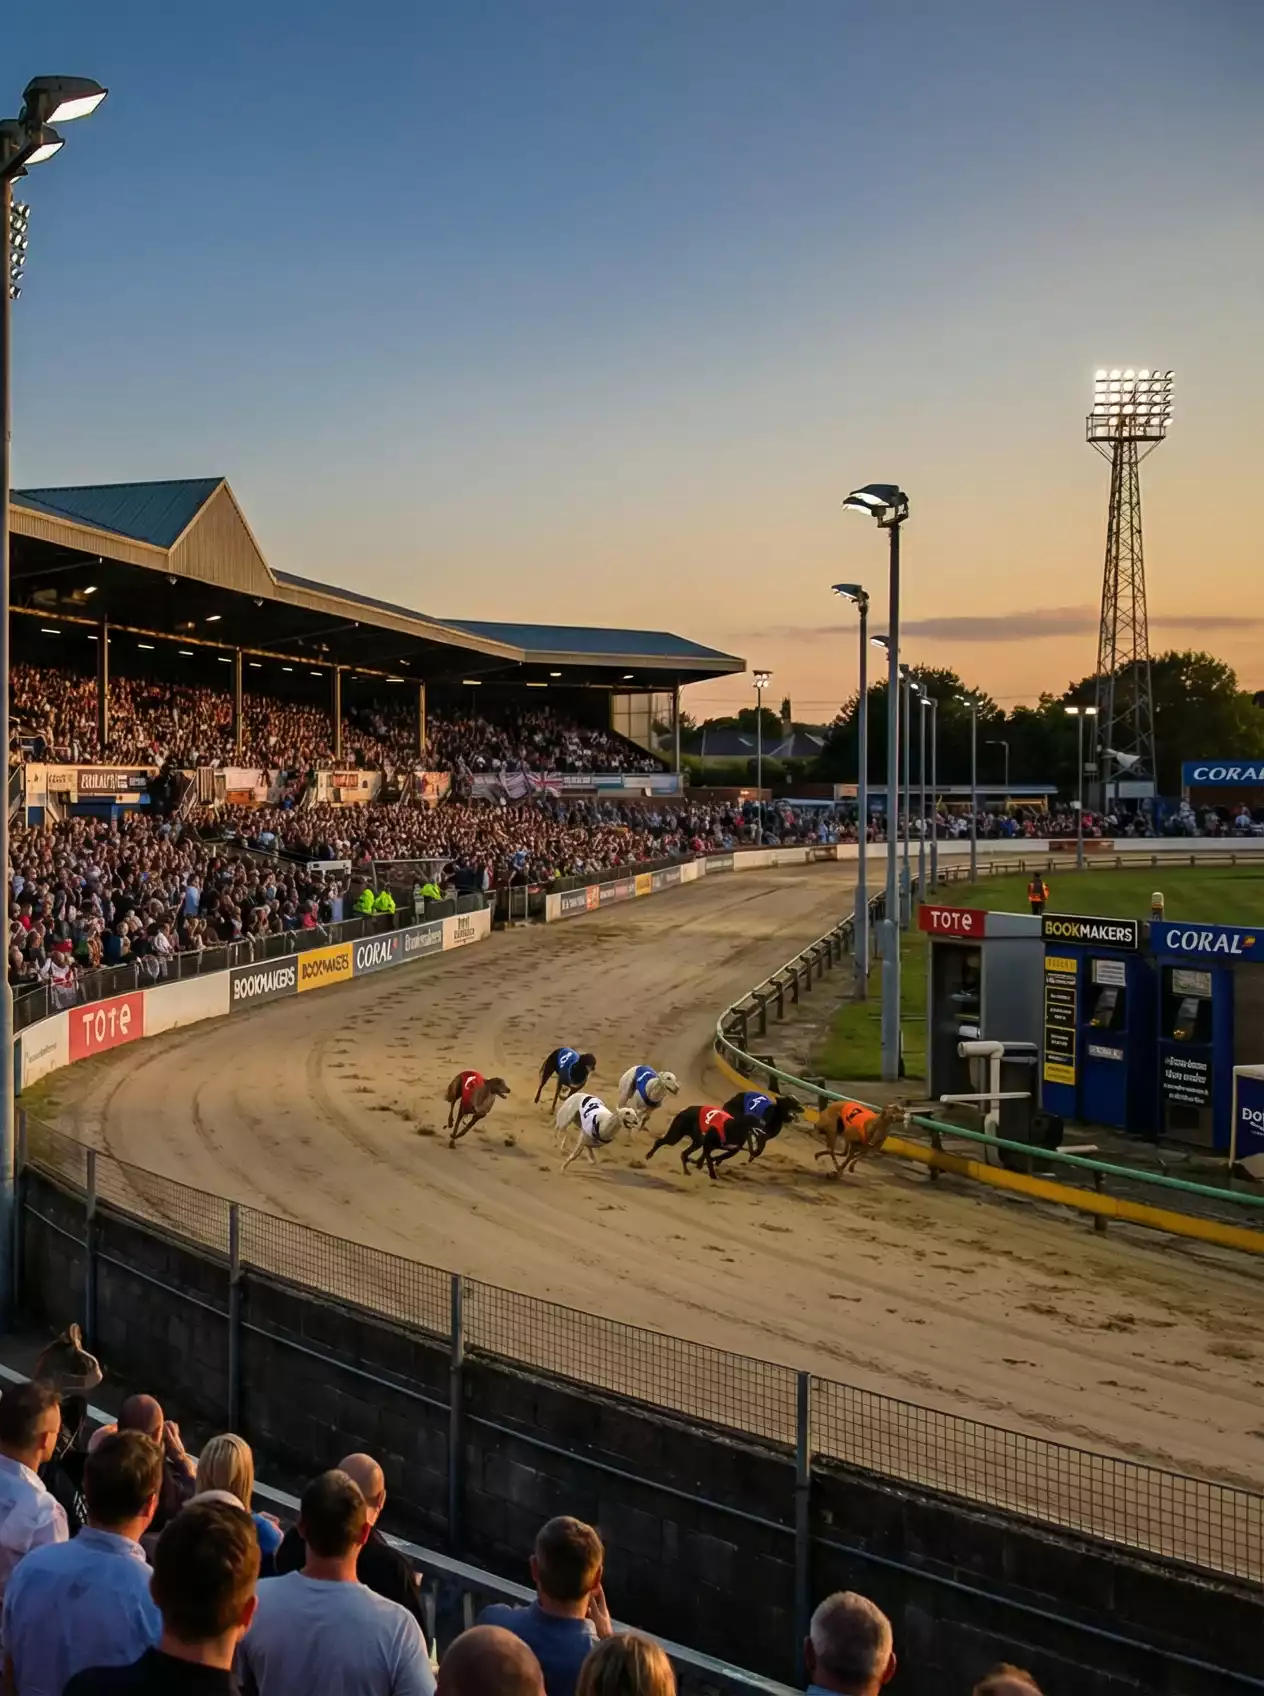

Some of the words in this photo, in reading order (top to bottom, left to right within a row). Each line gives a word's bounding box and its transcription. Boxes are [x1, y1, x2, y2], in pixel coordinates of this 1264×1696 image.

[1044, 919, 1133, 943] BOOKMAKERS
[1166, 929, 1243, 955] CORAL
[356, 938, 393, 969] CORAL
